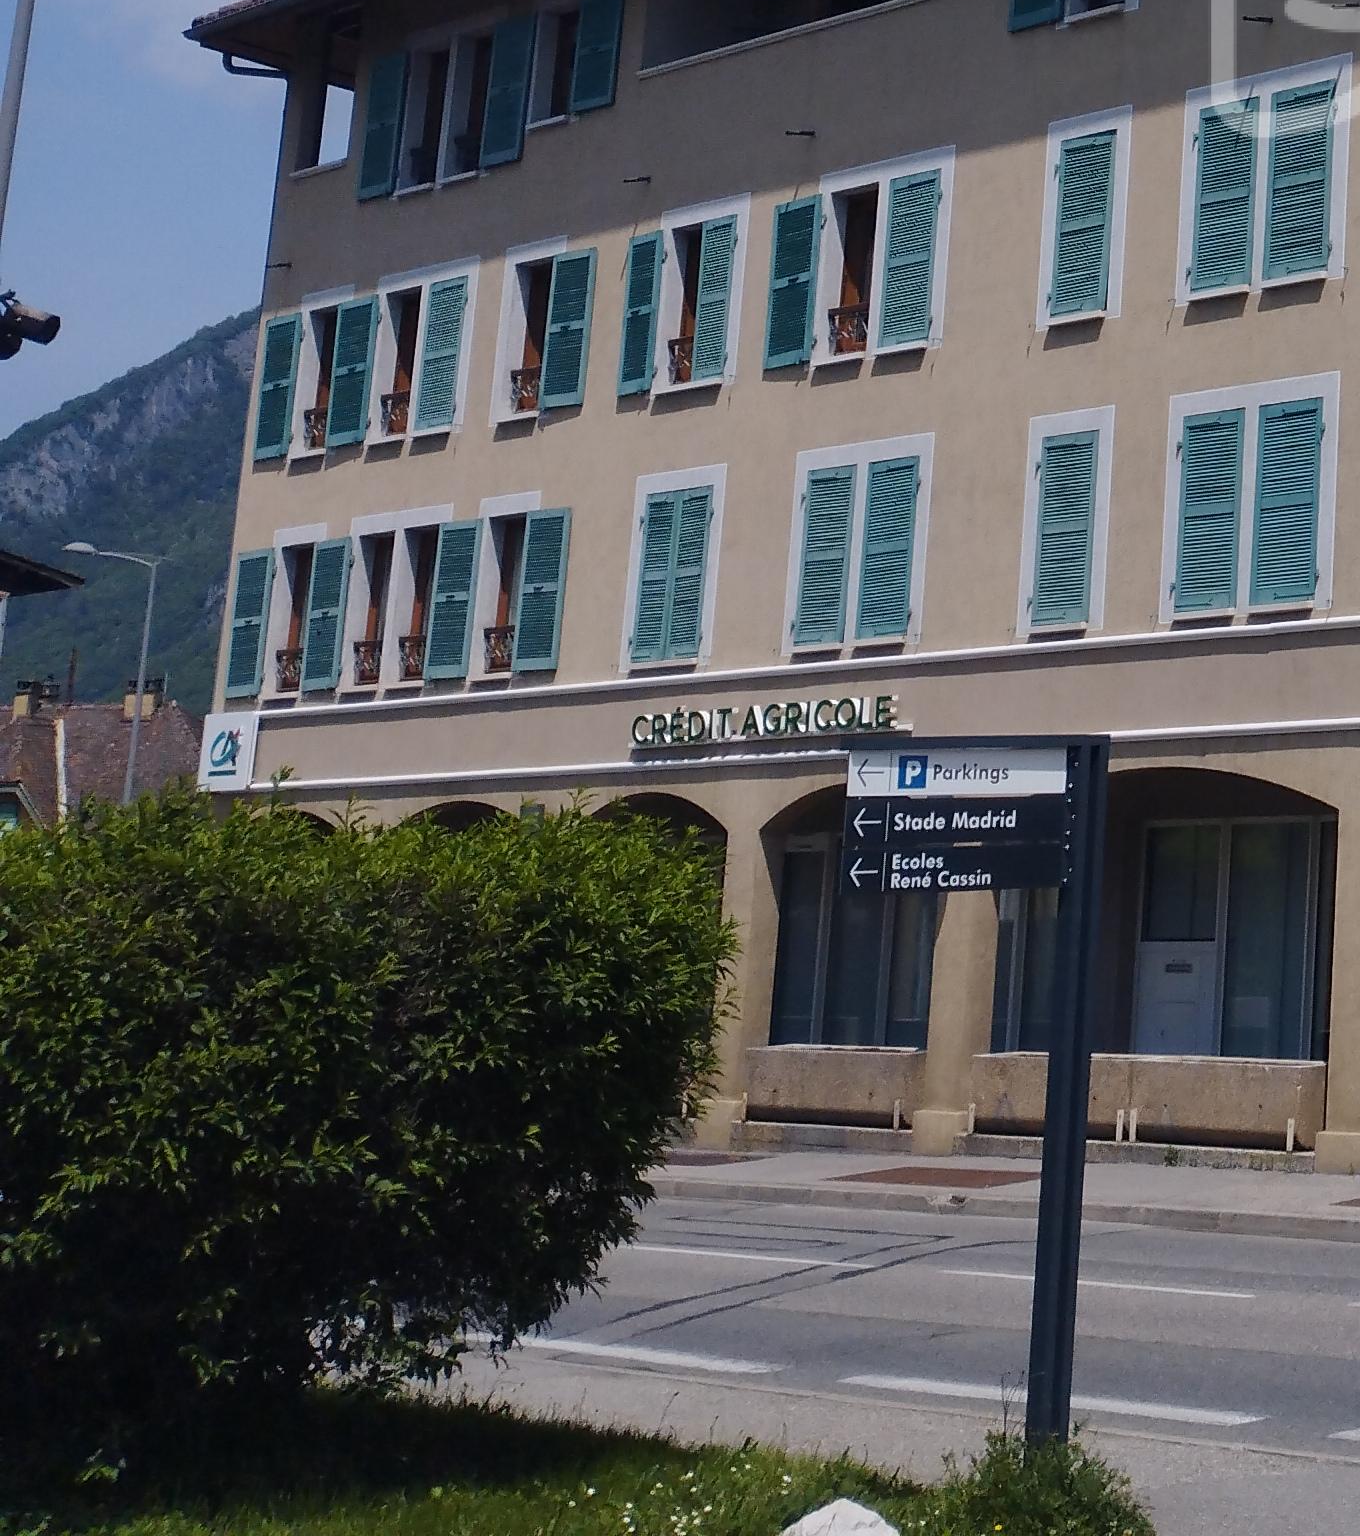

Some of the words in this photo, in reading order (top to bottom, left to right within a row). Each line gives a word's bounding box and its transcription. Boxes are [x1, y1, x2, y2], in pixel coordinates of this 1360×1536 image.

[632, 707, 734, 745] CRÉDIT
[741, 695, 898, 737] AGRICOLE
[933, 763, 1010, 784] Parkings
[894, 812, 946, 831] Stade
[952, 810, 1017, 829] Madrid
[891, 853, 943, 870] Ecoles
[891, 871, 931, 889] René
[937, 869, 992, 888] Cassin
